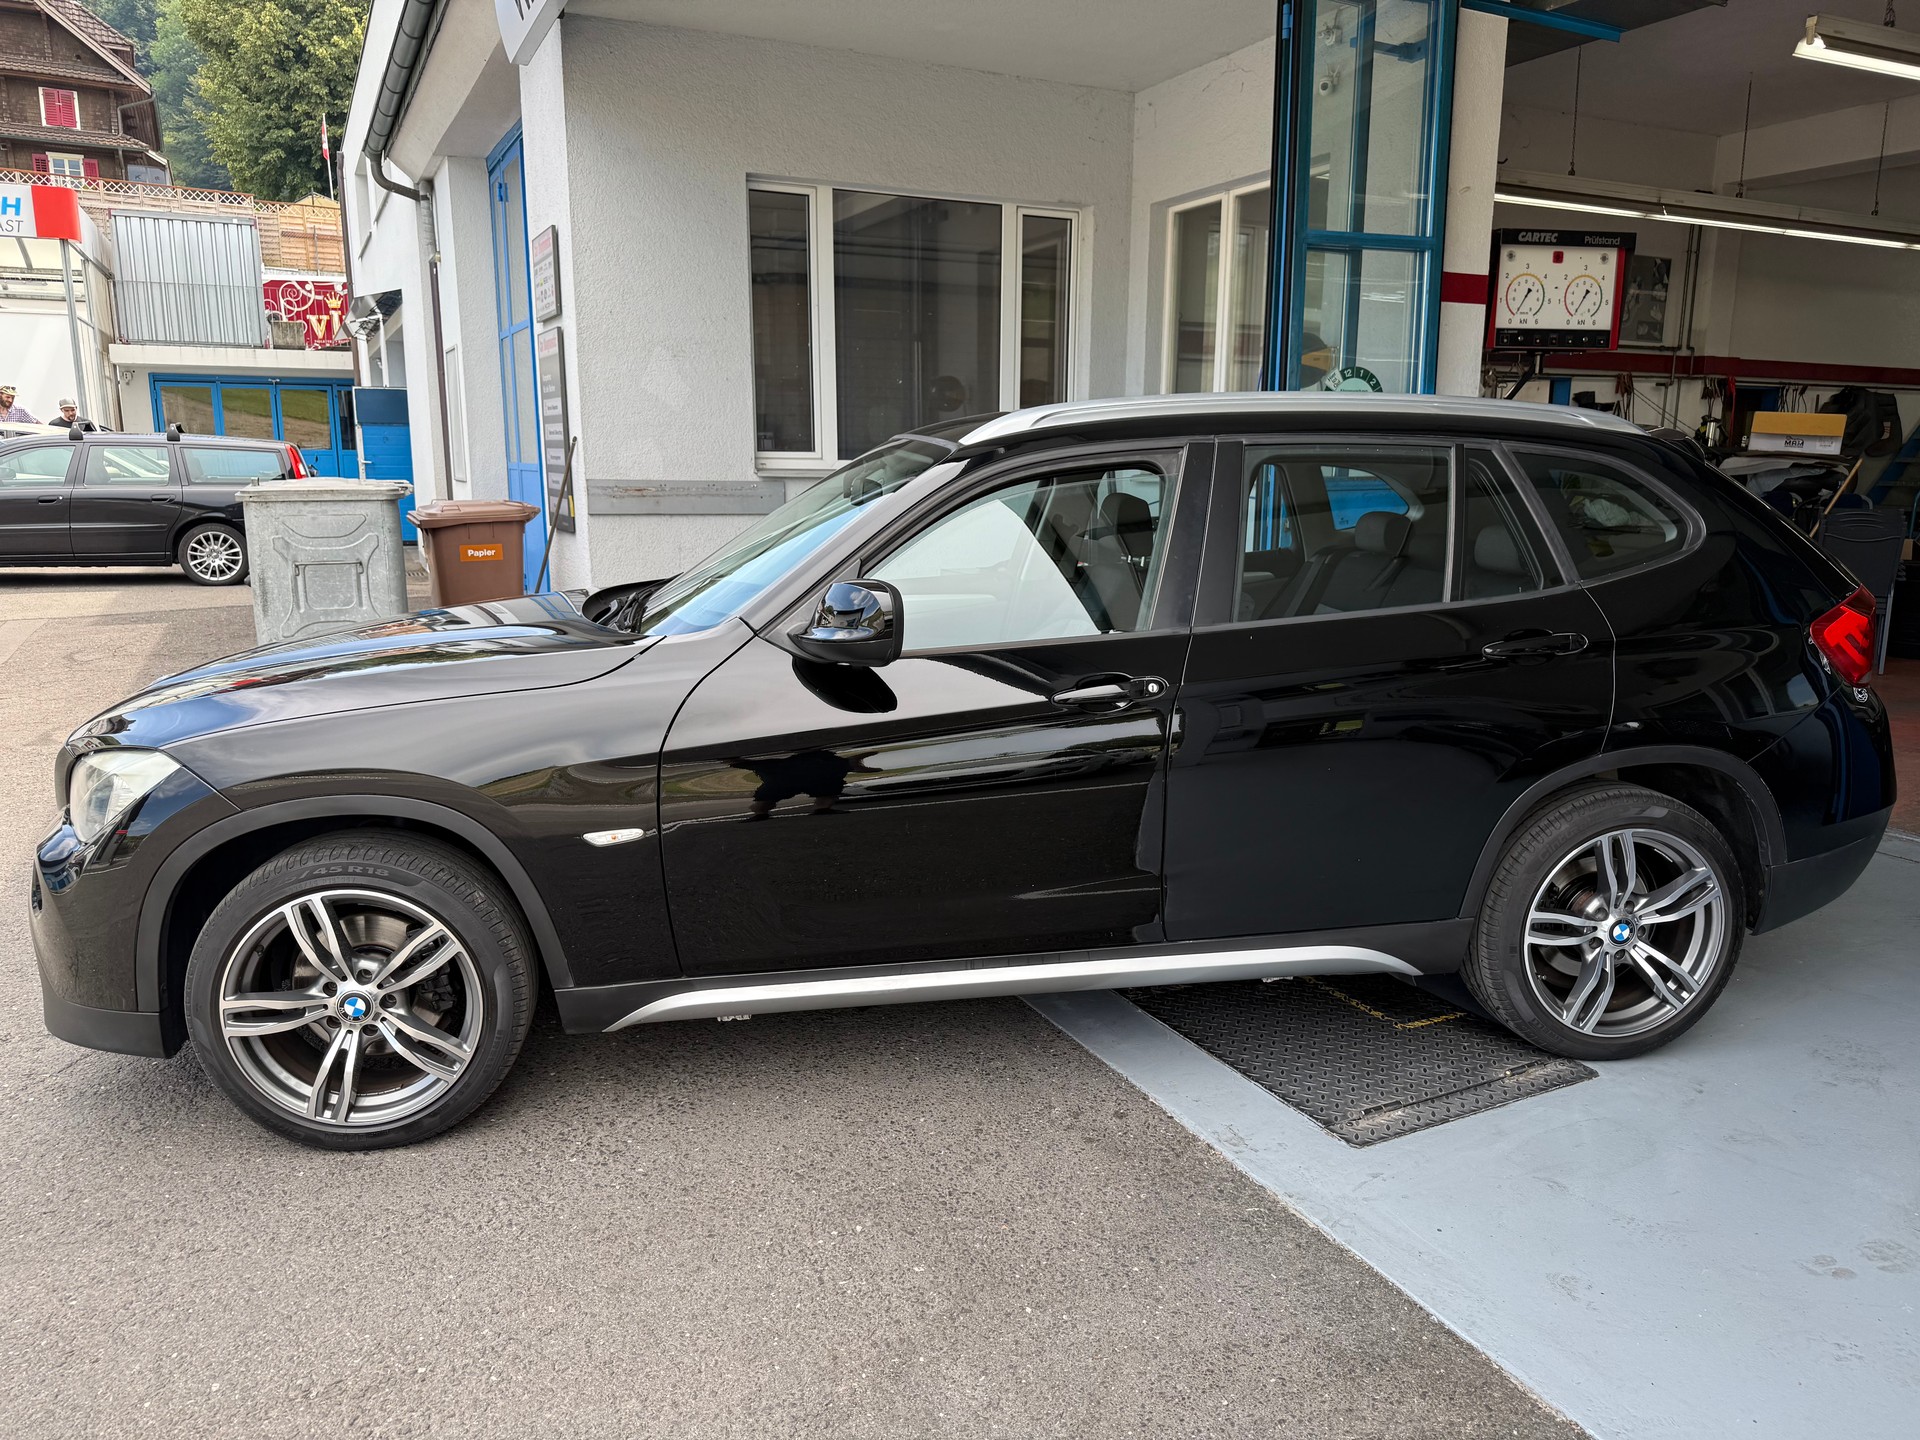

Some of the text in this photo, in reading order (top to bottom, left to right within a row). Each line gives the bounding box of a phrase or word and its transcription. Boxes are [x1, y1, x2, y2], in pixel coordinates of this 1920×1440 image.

[1, 196, 21, 216] H
[1518, 231, 1621, 246] CARTEC Prüfstand
[1344, 369, 1352, 377] 12
[1360, 369, 1364, 377] 1
[1369, 378, 1377, 386] 2
[467, 548, 496, 557] Papier
